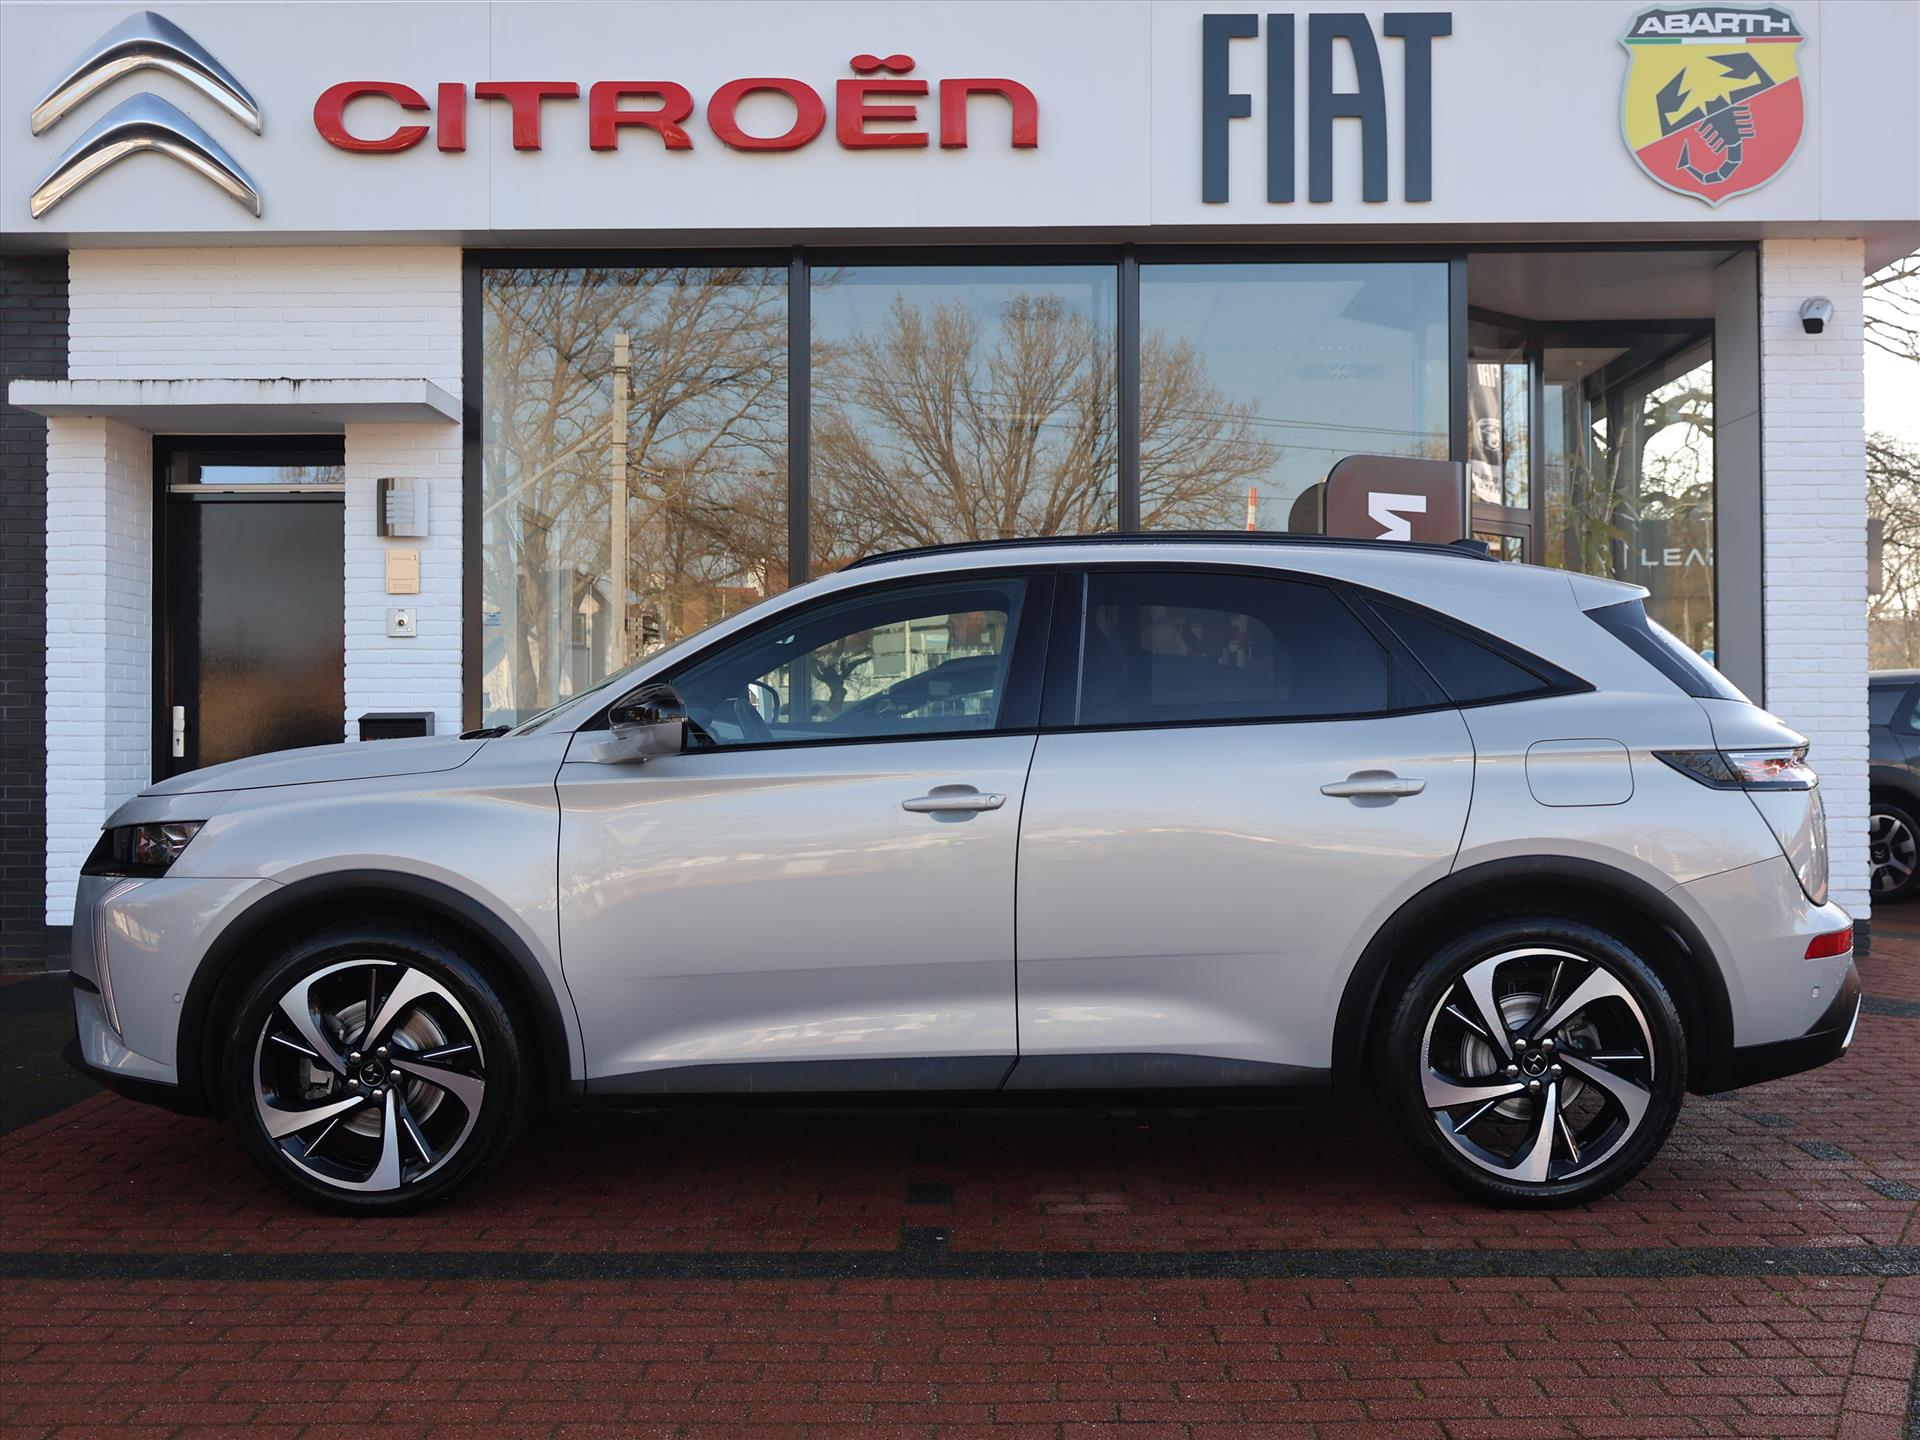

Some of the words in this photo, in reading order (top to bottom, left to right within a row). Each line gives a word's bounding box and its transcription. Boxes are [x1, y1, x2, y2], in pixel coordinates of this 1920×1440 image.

[1637, 12, 1791, 34] ABARTH
[313, 54, 1039, 154] CITROËN
[1202, 12, 1452, 204] FIAT
